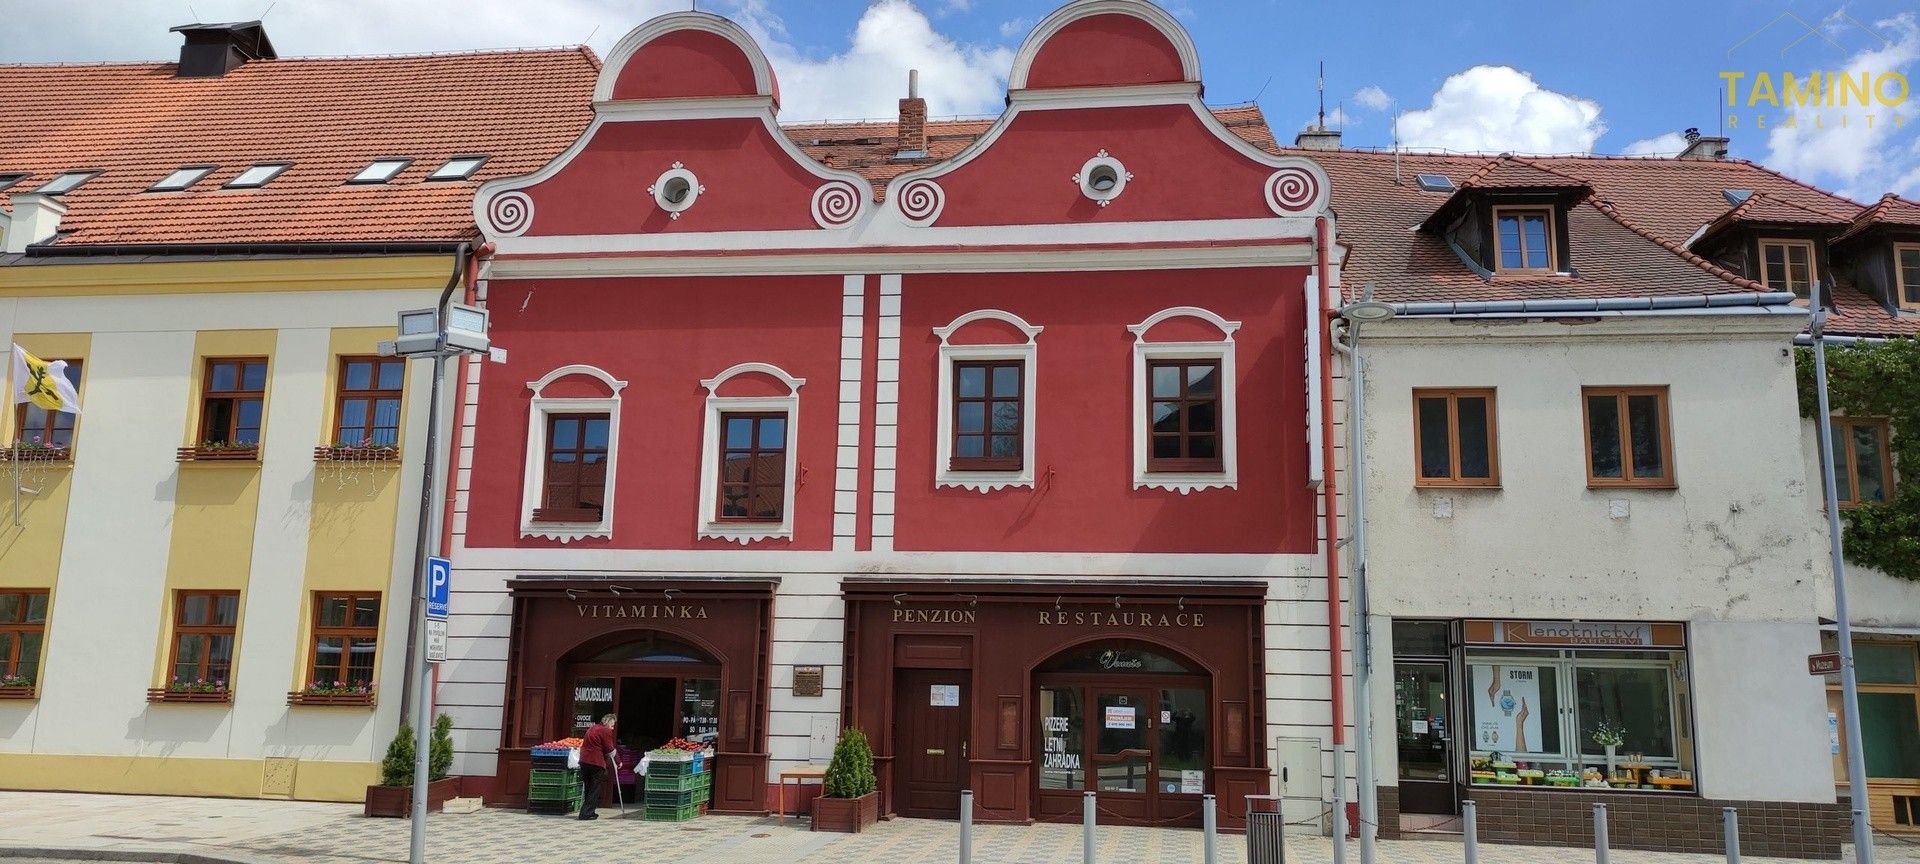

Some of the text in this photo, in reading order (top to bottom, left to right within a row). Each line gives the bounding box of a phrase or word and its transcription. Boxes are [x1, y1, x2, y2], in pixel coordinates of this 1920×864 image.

[432, 564, 446, 598] P
[577, 604, 708, 619] VITAMINKA
[892, 609, 976, 623] PENZION
[1038, 611, 1205, 627] RESTAURACE
[1506, 622, 1641, 642] Klenotnictví
[1509, 670, 1533, 680] STORM
[575, 687, 612, 701] SAMOOBSLUHA
[1044, 716, 1069, 732] PIZZERIE
[1044, 734, 1063, 752] LETNÍ
[1044, 751, 1081, 769] ZAHRÁDKA
